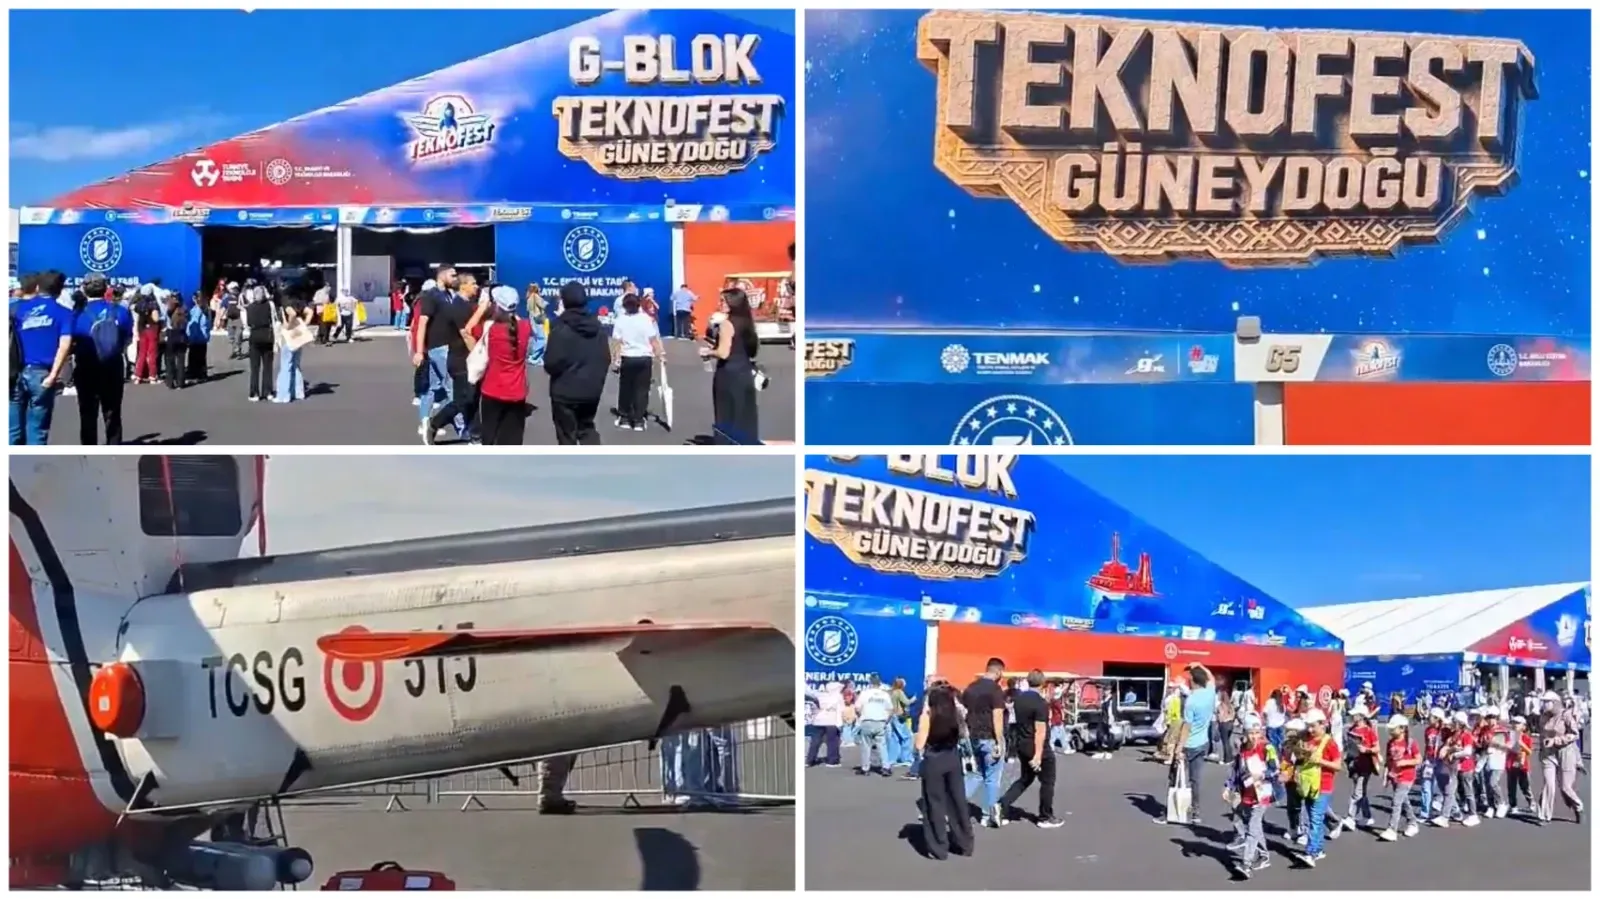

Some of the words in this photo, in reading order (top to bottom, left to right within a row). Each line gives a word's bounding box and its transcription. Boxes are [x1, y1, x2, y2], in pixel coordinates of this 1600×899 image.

[569, 34, 761, 84] G-BLOK
[930, 17, 1519, 142] TEKNOFEST
[556, 96, 779, 137] TEKNOFEST
[601, 136, 746, 165] GÜNEYDOĞU
[1054, 142, 1441, 213] GÜNEYDOĞU
[971, 351, 1050, 365] TENMAK
[1266, 345, 1301, 373] G5
[806, 472, 1032, 546] TEKNOFEST
[852, 526, 1001, 567] GÜNEYDOĞU
[201, 647, 305, 718] TCSG
